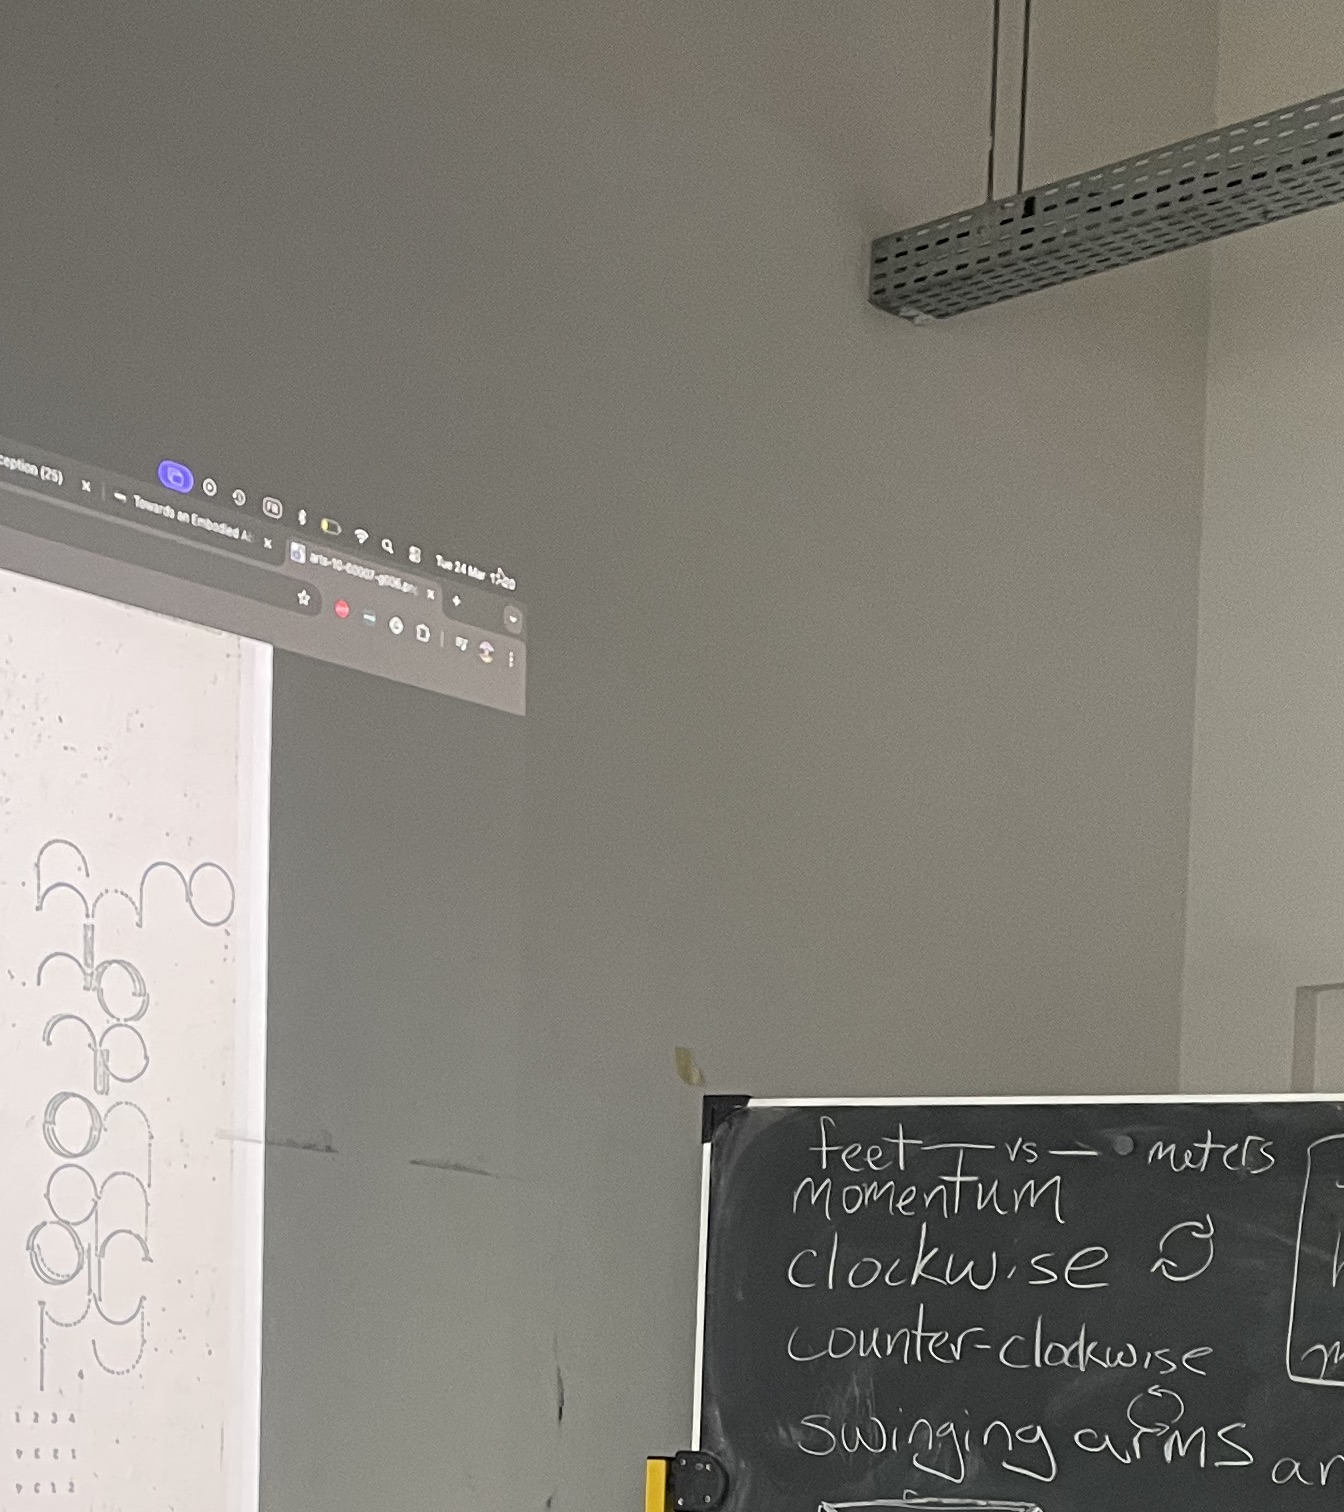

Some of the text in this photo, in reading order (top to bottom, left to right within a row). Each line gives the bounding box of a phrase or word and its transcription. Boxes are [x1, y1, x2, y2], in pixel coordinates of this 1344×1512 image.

[808, 1115, 1275, 1176] feet vs meters
[792, 1149, 1067, 1224] momentum
[787, 1222, 1110, 1291] clockwise
[787, 1303, 1214, 1377] counter-clockwise
[797, 1408, 1255, 1484] swinging arms
